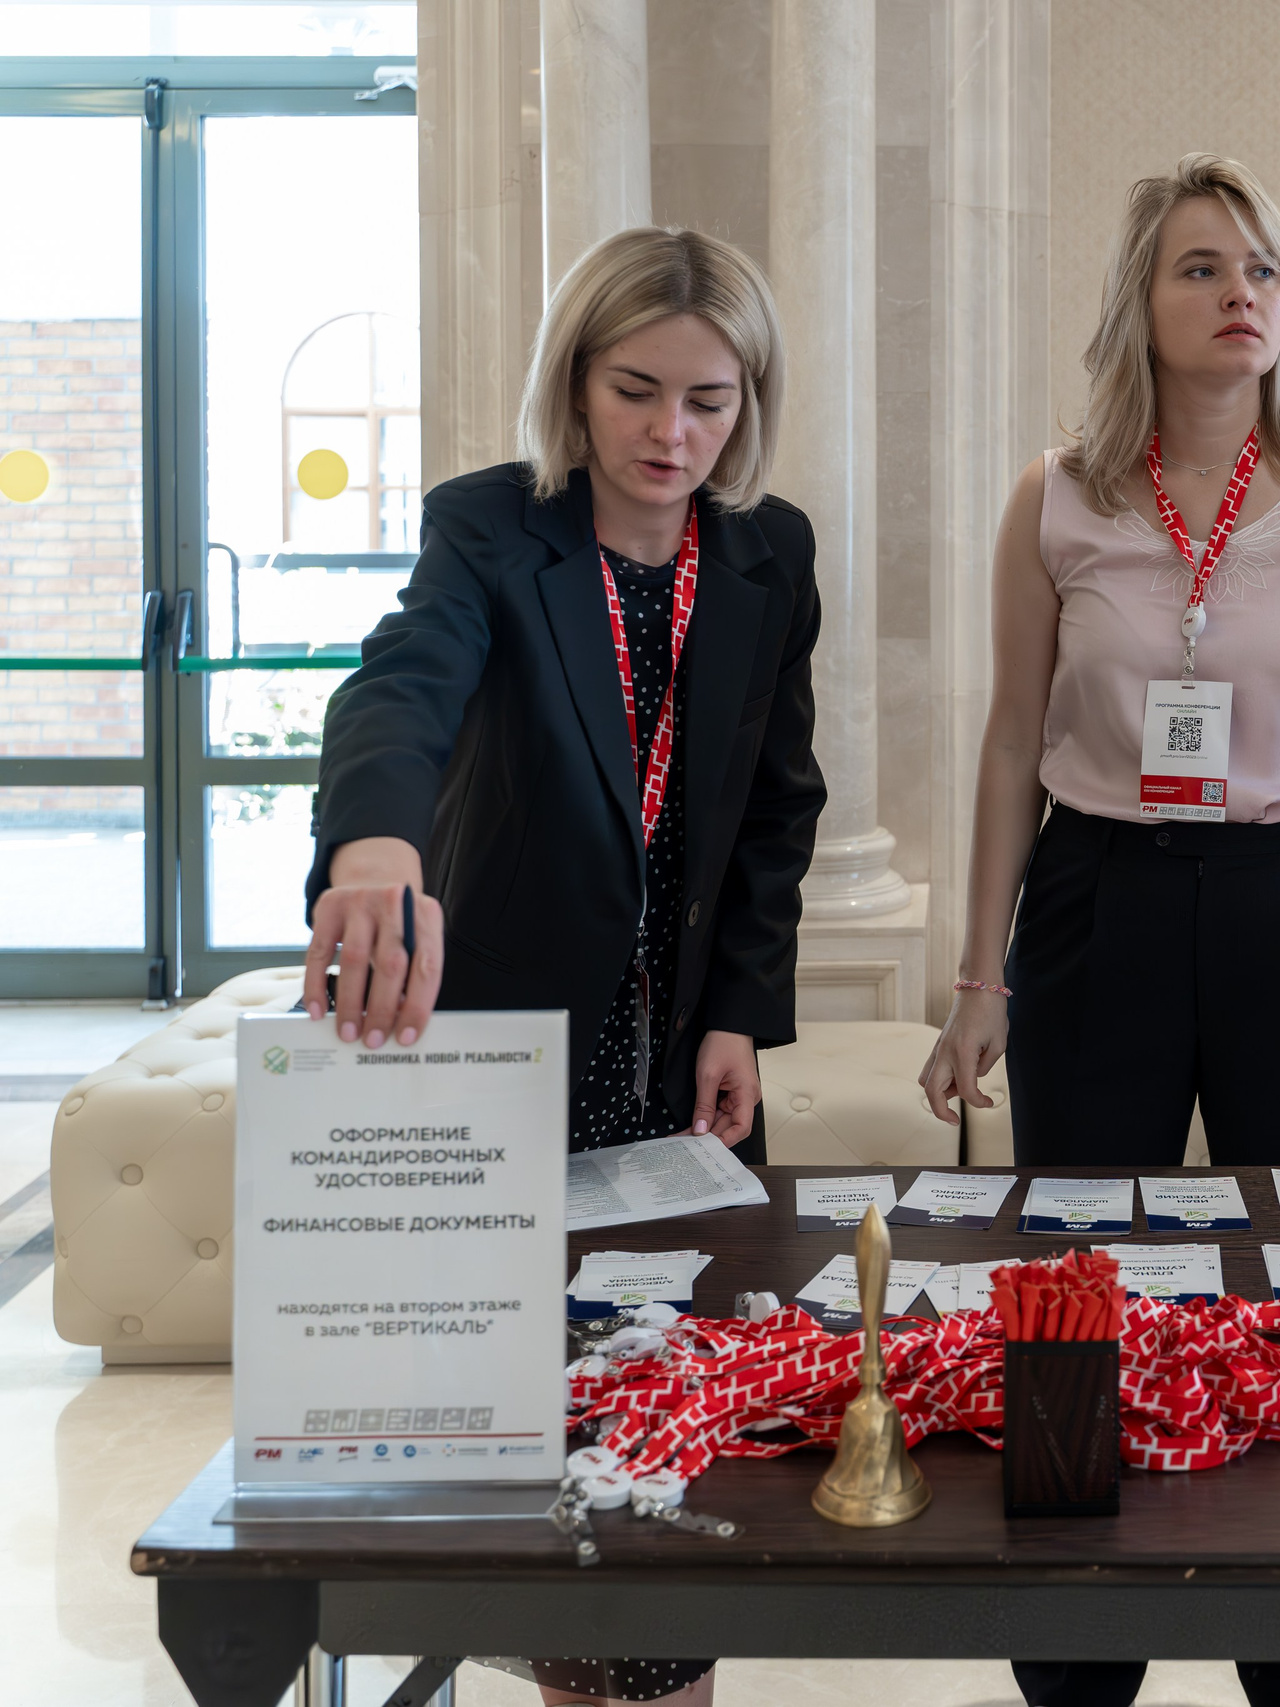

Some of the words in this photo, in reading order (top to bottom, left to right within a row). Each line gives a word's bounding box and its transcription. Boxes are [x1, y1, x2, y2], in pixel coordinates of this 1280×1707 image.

[1142, 805, 1158, 813] PM
[356, 1052, 420, 1065] ЭКОНОМИКА
[425, 1050, 460, 1064] НОВОЙ
[464, 1051, 532, 1064] РЕАЛЬНОСТИ
[330, 1126, 472, 1144] ОФОРМЛЕНИЕ
[291, 1148, 506, 1167] КОМАНДИРОВОЧНЫХ
[315, 1168, 486, 1190] УДОСТОВЕРЕНИЙ
[817, 1196, 874, 1204] ДМИТРИЙ
[264, 1216, 405, 1234] ФИНАНСОВЫЕ
[409, 1214, 536, 1234] ДОКУМЕНТЫ
[602, 1280, 674, 1288] АЛЕКСАНДРА
[278, 1302, 368, 1316] находятся
[374, 1302, 394, 1314] на
[400, 1300, 464, 1312] втором
[468, 1299, 522, 1312] этаже
[821, 1312, 852, 1320] PM
[305, 1326, 314, 1337] в
[320, 1325, 360, 1337] зале
[254, 1448, 282, 1458] PM
